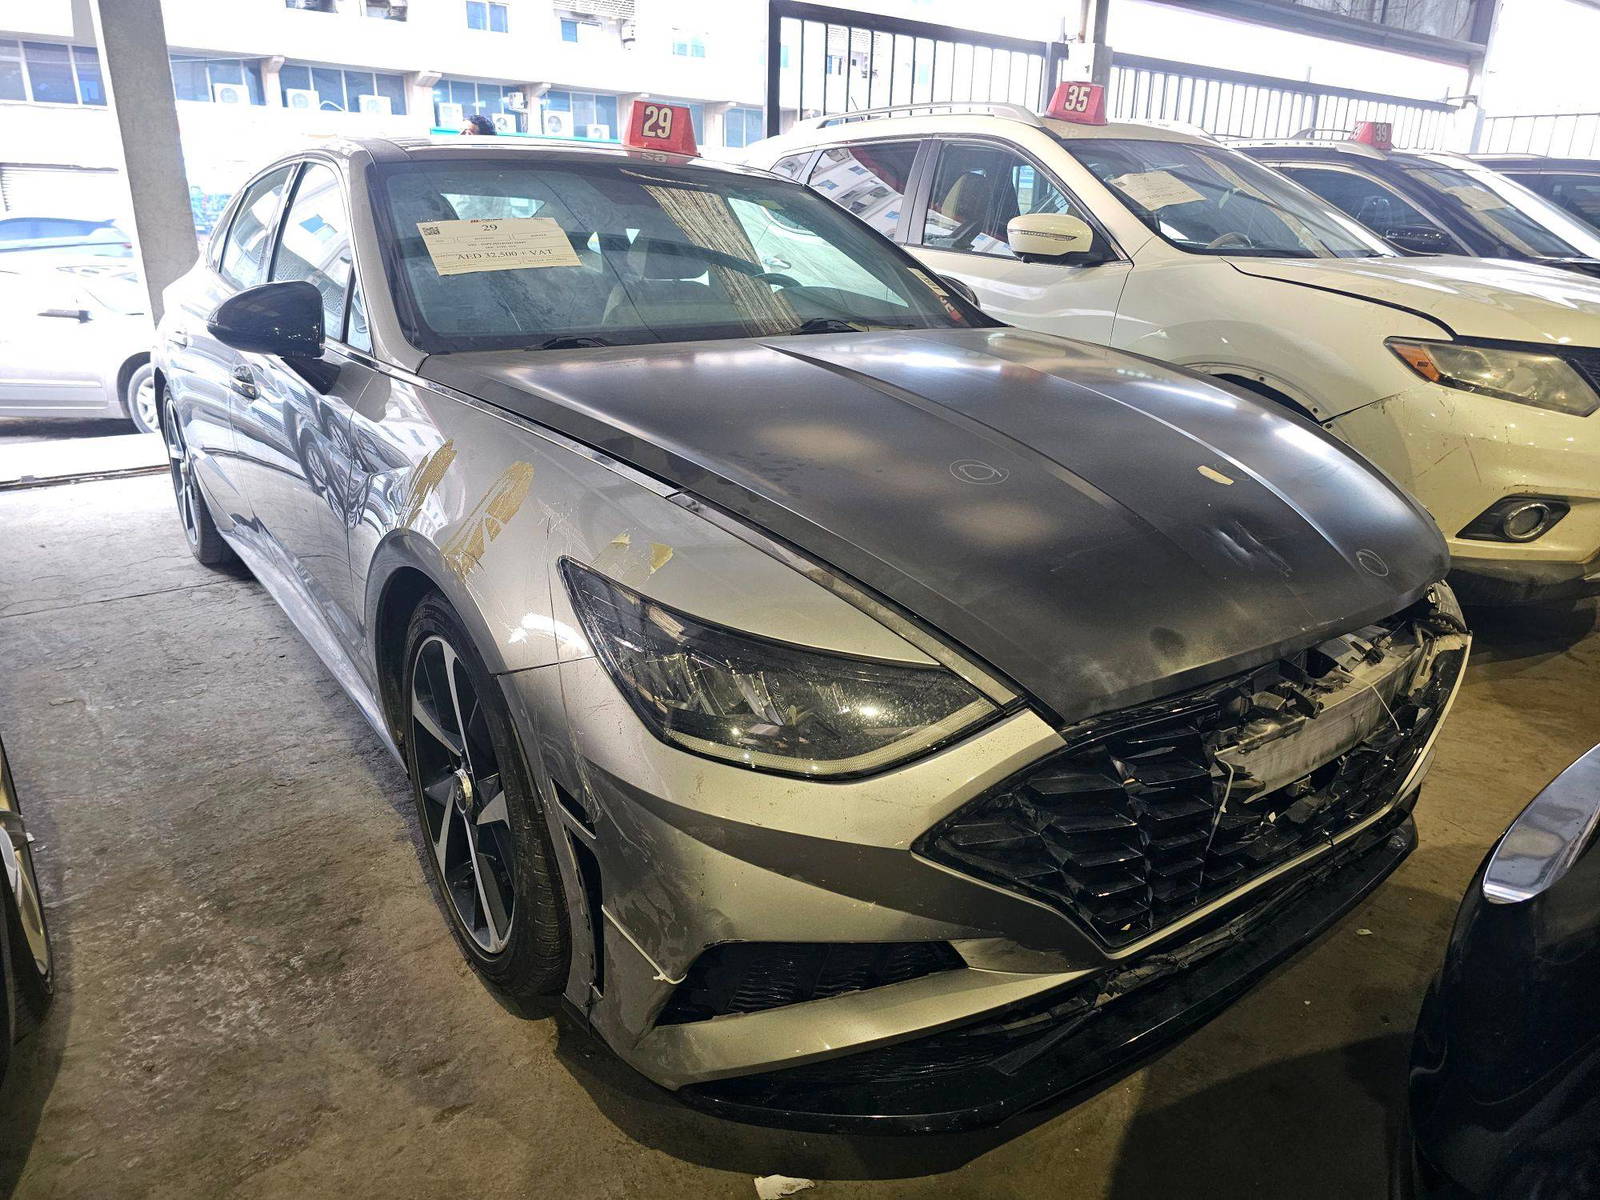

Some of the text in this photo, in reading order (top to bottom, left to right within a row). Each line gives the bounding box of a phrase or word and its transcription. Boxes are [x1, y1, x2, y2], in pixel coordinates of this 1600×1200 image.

[1065, 85, 1090, 112] 35
[643, 105, 672, 138] 29
[1376, 123, 1387, 142] 39
